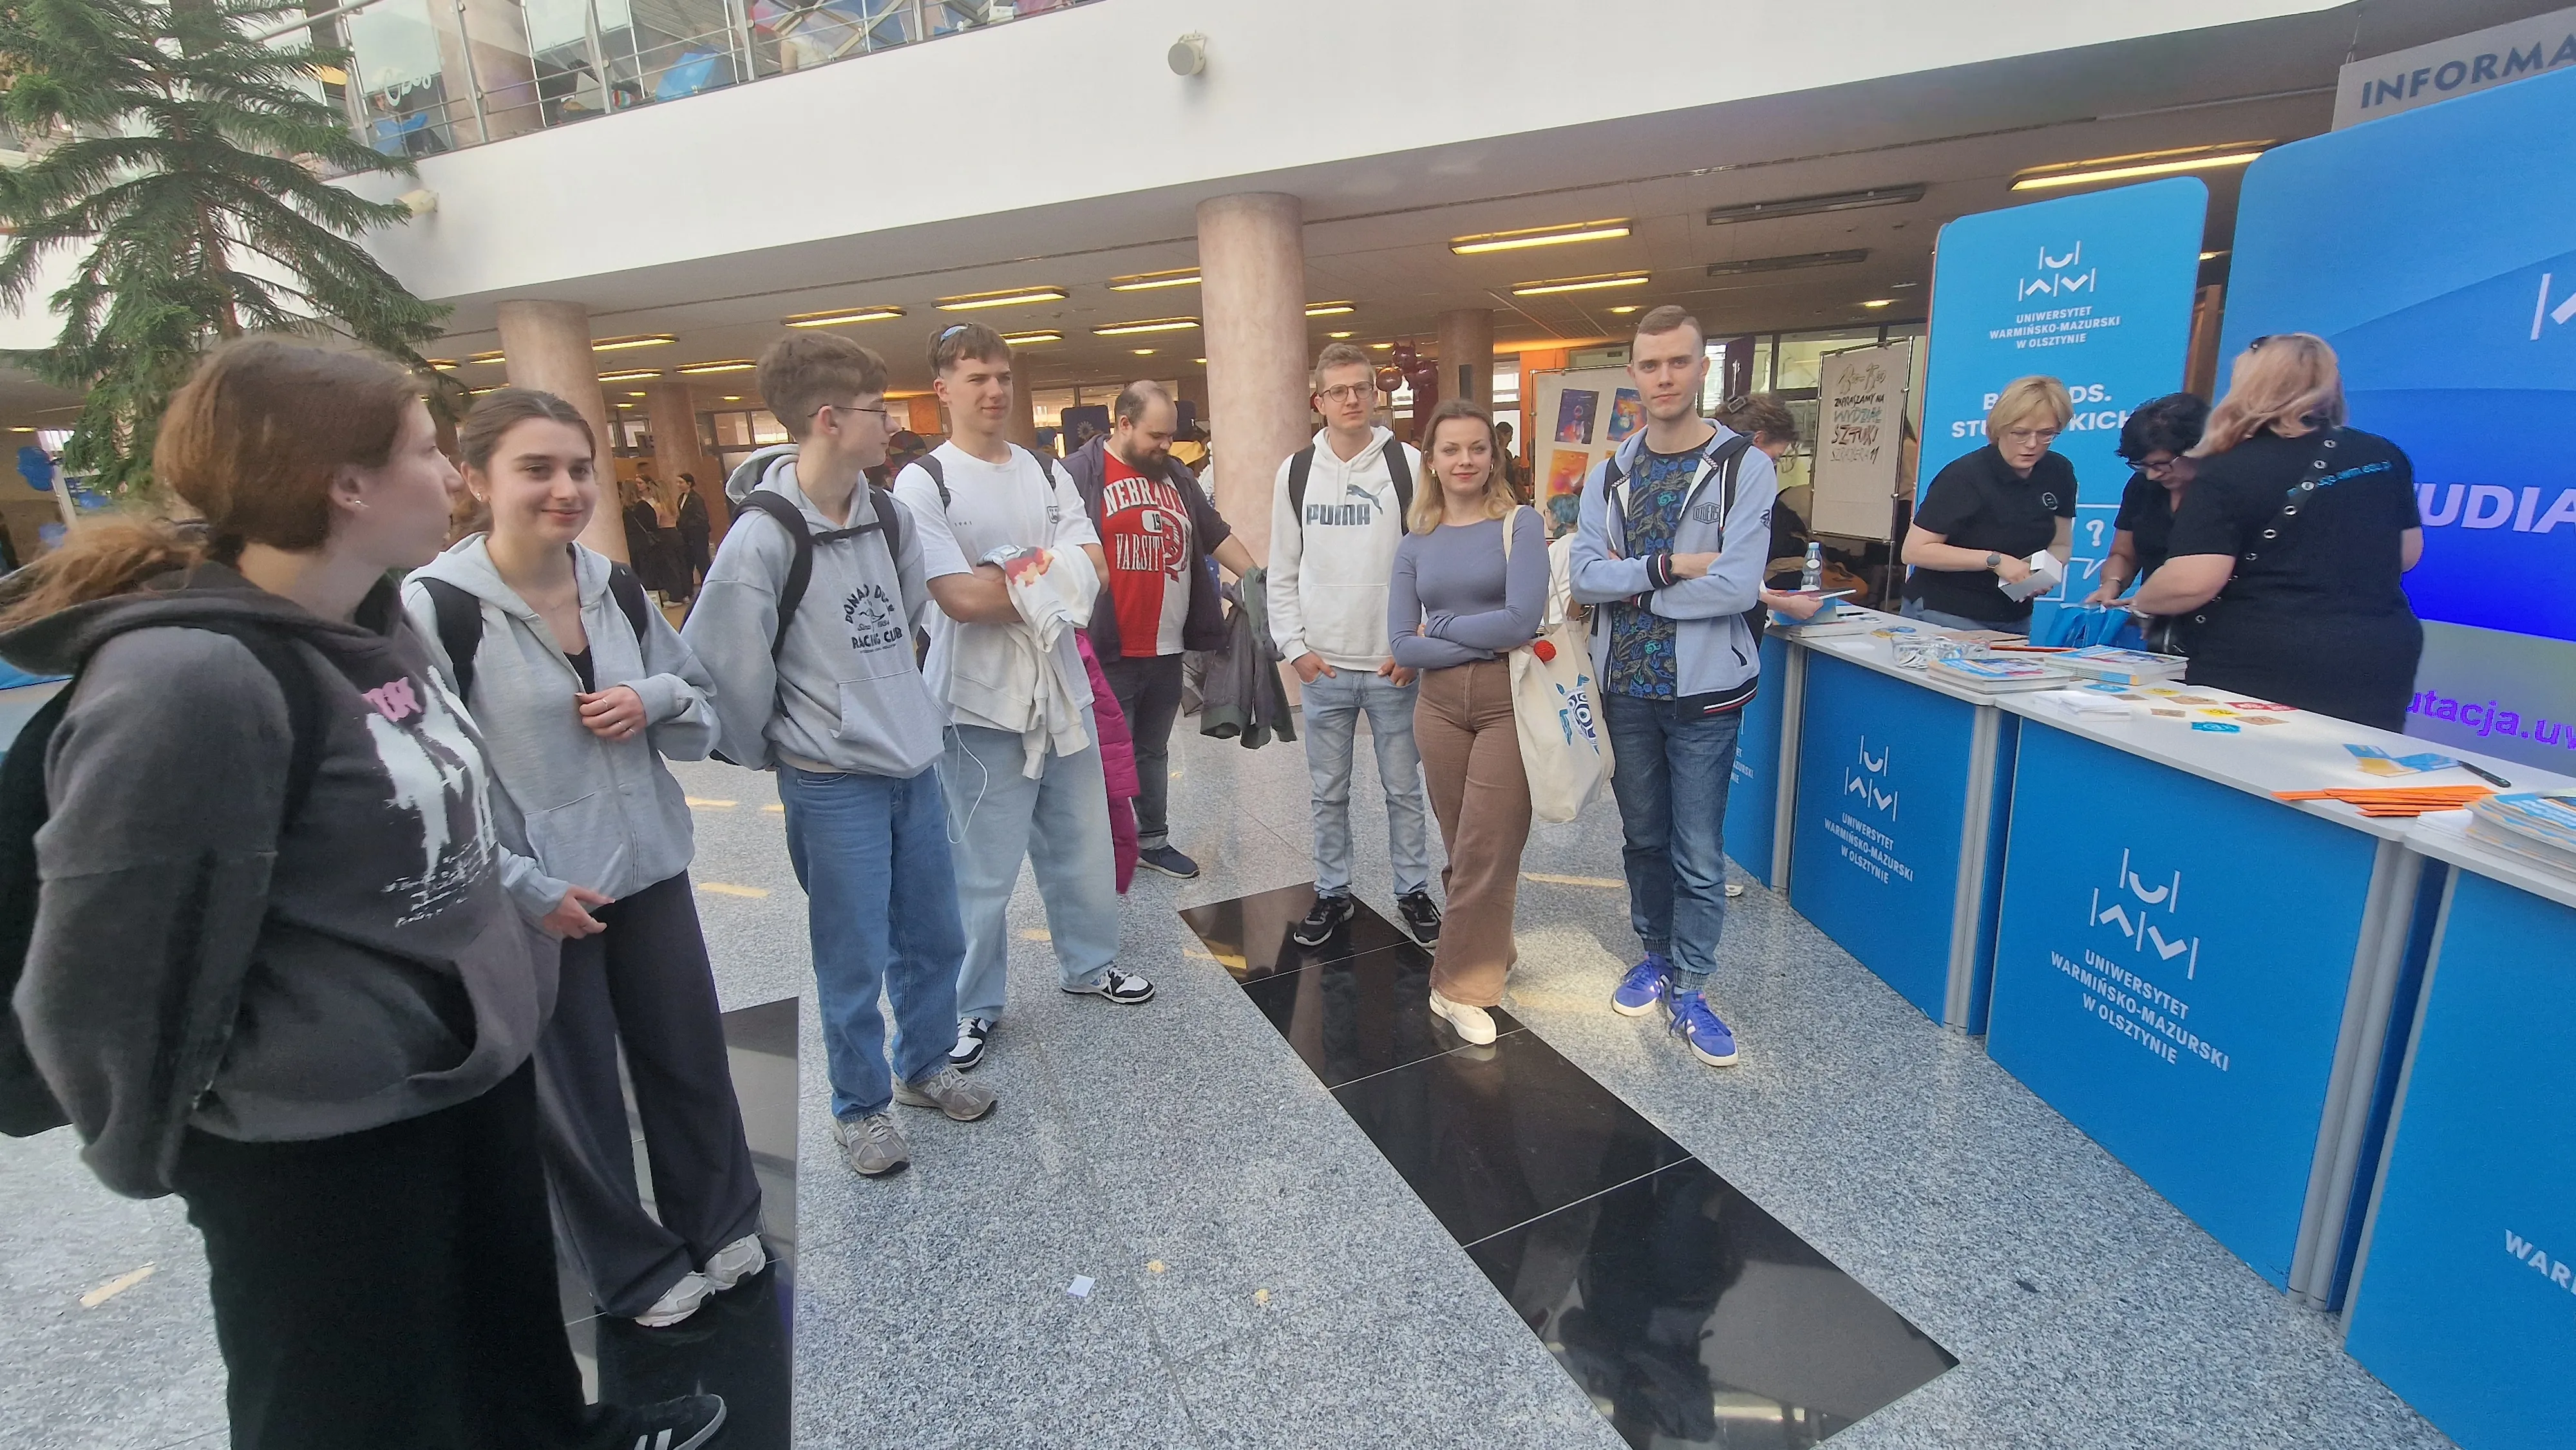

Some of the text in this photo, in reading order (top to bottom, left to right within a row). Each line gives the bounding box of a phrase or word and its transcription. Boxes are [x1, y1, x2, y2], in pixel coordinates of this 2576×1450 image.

[1989, 316, 2121, 339] WARMIŃSKO-MAZURSKI
[2016, 306, 2092, 323] UNIWERSYTET
[2016, 333, 2087, 349] W OLSZTYNIE
[1306, 504, 1370, 525] PUMA
[2414, 483, 2576, 534] UDIA
[1824, 817, 1913, 883] WARMIŃSKO-MAZURSKI
[1842, 813, 1893, 851] UNIWERSYTET
[1841, 845, 1889, 885] W OLSZTYNIE
[2085, 948, 2190, 1020] UNIWERSYTET
[2050, 950, 2230, 1073] WARMIŃSKO-MAZURSKI
[2083, 993, 2177, 1065] W OLSZTYNIE
[2505, 1229, 2576, 1295] WAR
